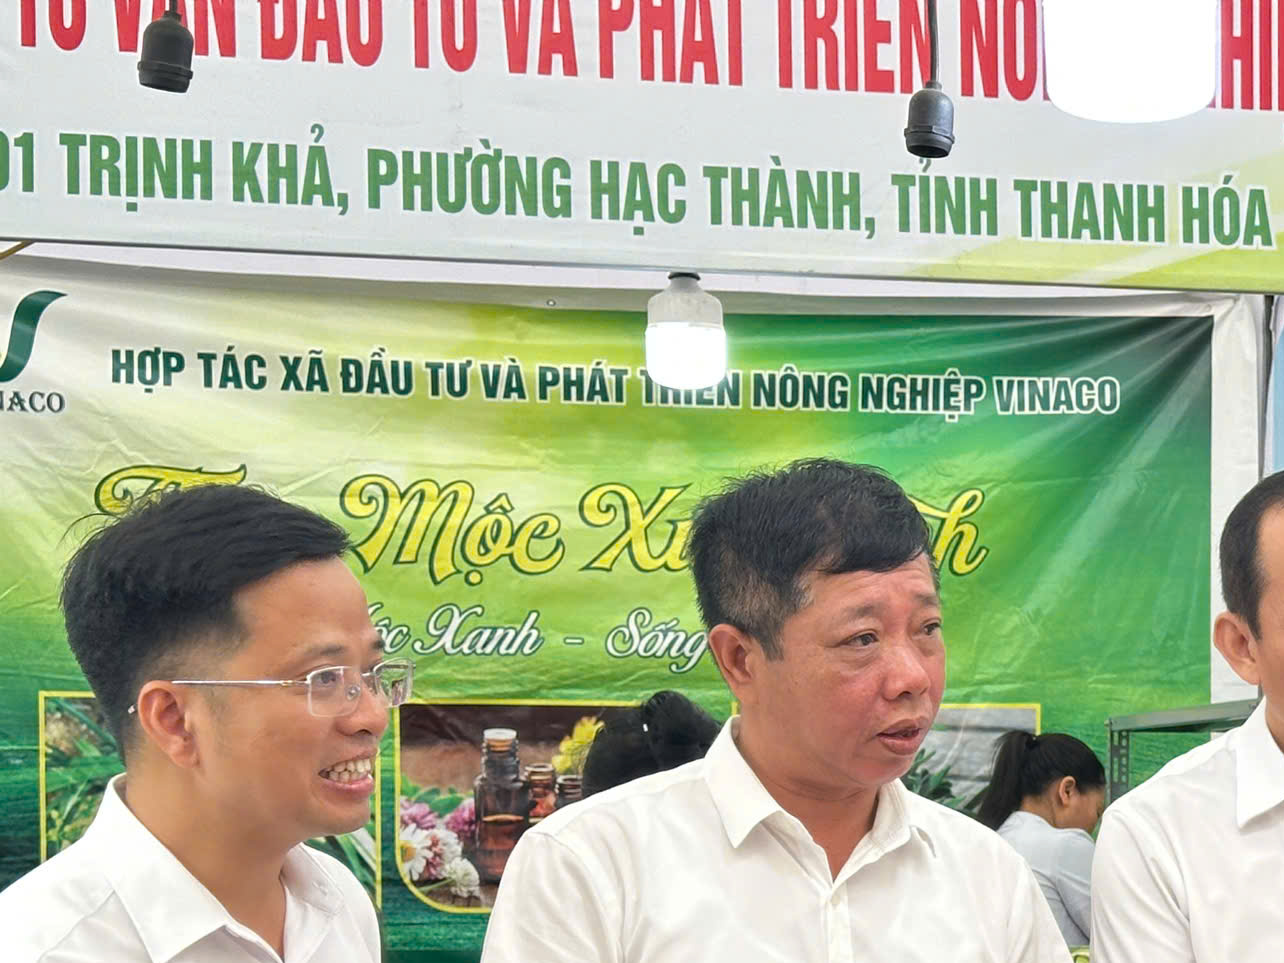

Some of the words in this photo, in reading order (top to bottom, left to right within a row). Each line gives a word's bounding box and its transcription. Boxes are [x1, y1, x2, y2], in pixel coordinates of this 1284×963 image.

[58, 132, 213, 212] TRỊNH
[232, 123, 350, 216] KHẢ,
[367, 138, 573, 219] PHƯỜNG
[591, 160, 687, 235] HẠC
[703, 155, 876, 240] THÀNH,
[891, 157, 998, 237] TỈNH
[1013, 179, 1166, 244] THANH
[1181, 174, 1274, 247] HÓA
[0, 390, 65, 413] ACO
[111, 347, 185, 393] HỢP
[197, 344, 267, 391] TÁC
[280, 349, 326, 393] XÃ
[340, 346, 413, 396] ĐẦU
[424, 358, 474, 398] TƯ
[481, 357, 527, 401] VÀ
[538, 359, 625, 406] PHÁT
[752, 364, 848, 411] NÔNG
[861, 368, 984, 422] NGHIỆP
[995, 376, 1120, 415] VINACO
[340, 472, 565, 587] Mộc
[411, 602, 545, 657] Xanh
[605, 607, 708, 674] Sống
